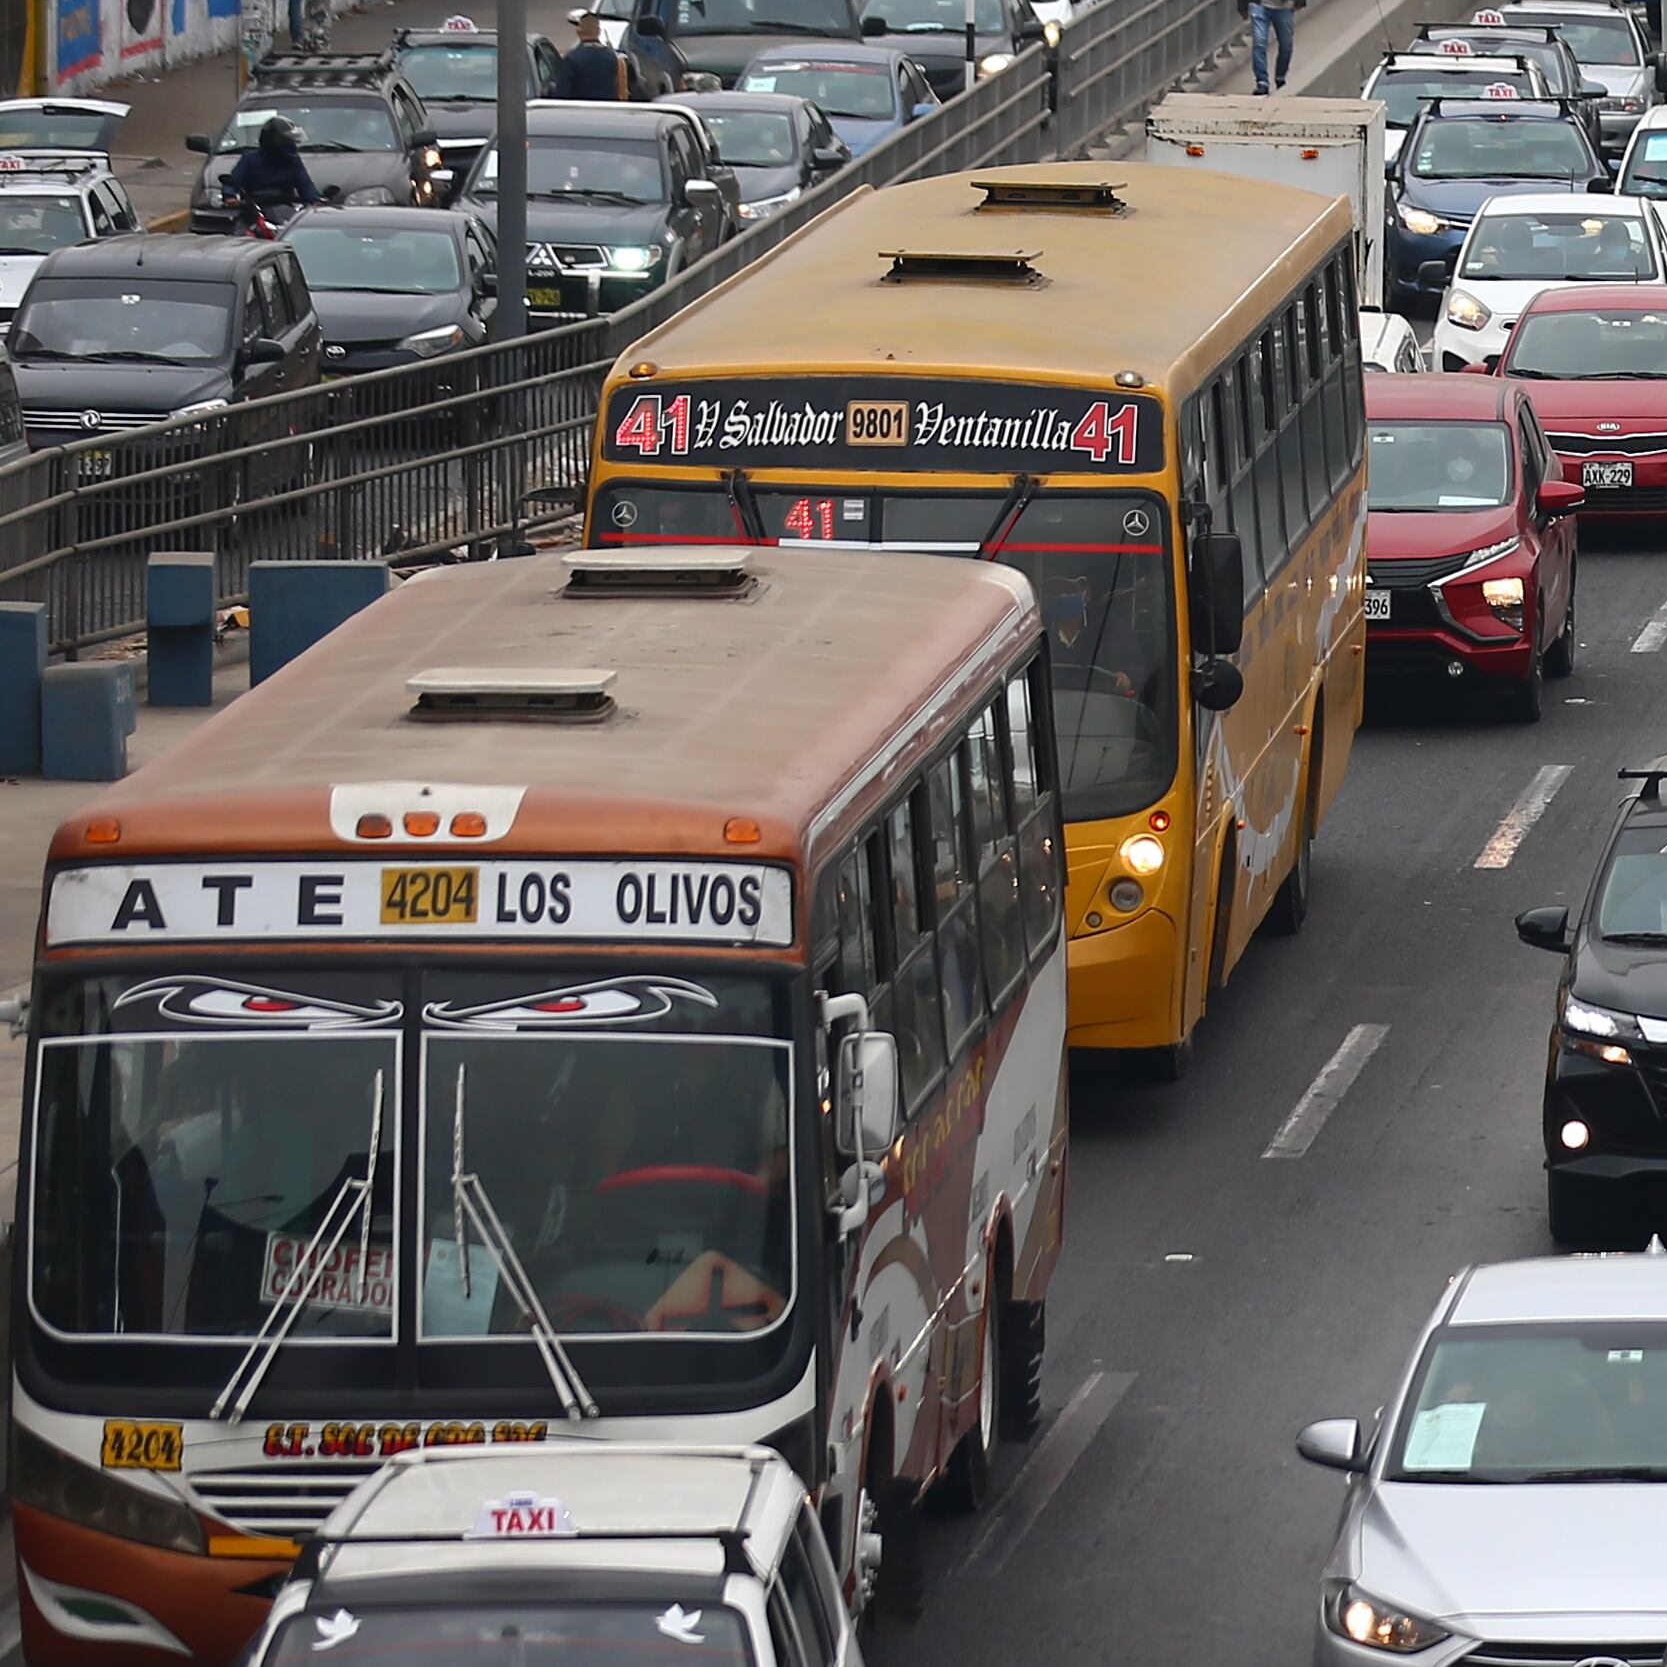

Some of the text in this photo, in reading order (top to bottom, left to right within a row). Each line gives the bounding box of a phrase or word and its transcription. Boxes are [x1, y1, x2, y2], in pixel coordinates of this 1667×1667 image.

[1478, 15, 1500, 23] TAXI
[1443, 44, 1467, 53] TAXI
[1490, 88, 1512, 97] TAXI
[616, 395, 691, 455] 41
[719, 400, 844, 448] Salvador
[852, 406, 905, 438] 9801
[913, 401, 1071, 451] Ventanilla
[1070, 400, 1139, 463] 41
[1584, 469, 1631, 486] AXK-229
[784, 499, 833, 540] 41
[387, 868, 475, 919] 4204
[497, 872, 572, 923] LOS
[616, 872, 761, 925] OLIVOS
[111, 1429, 177, 1462] 4204
[491, 1507, 555, 1533] TAXI
